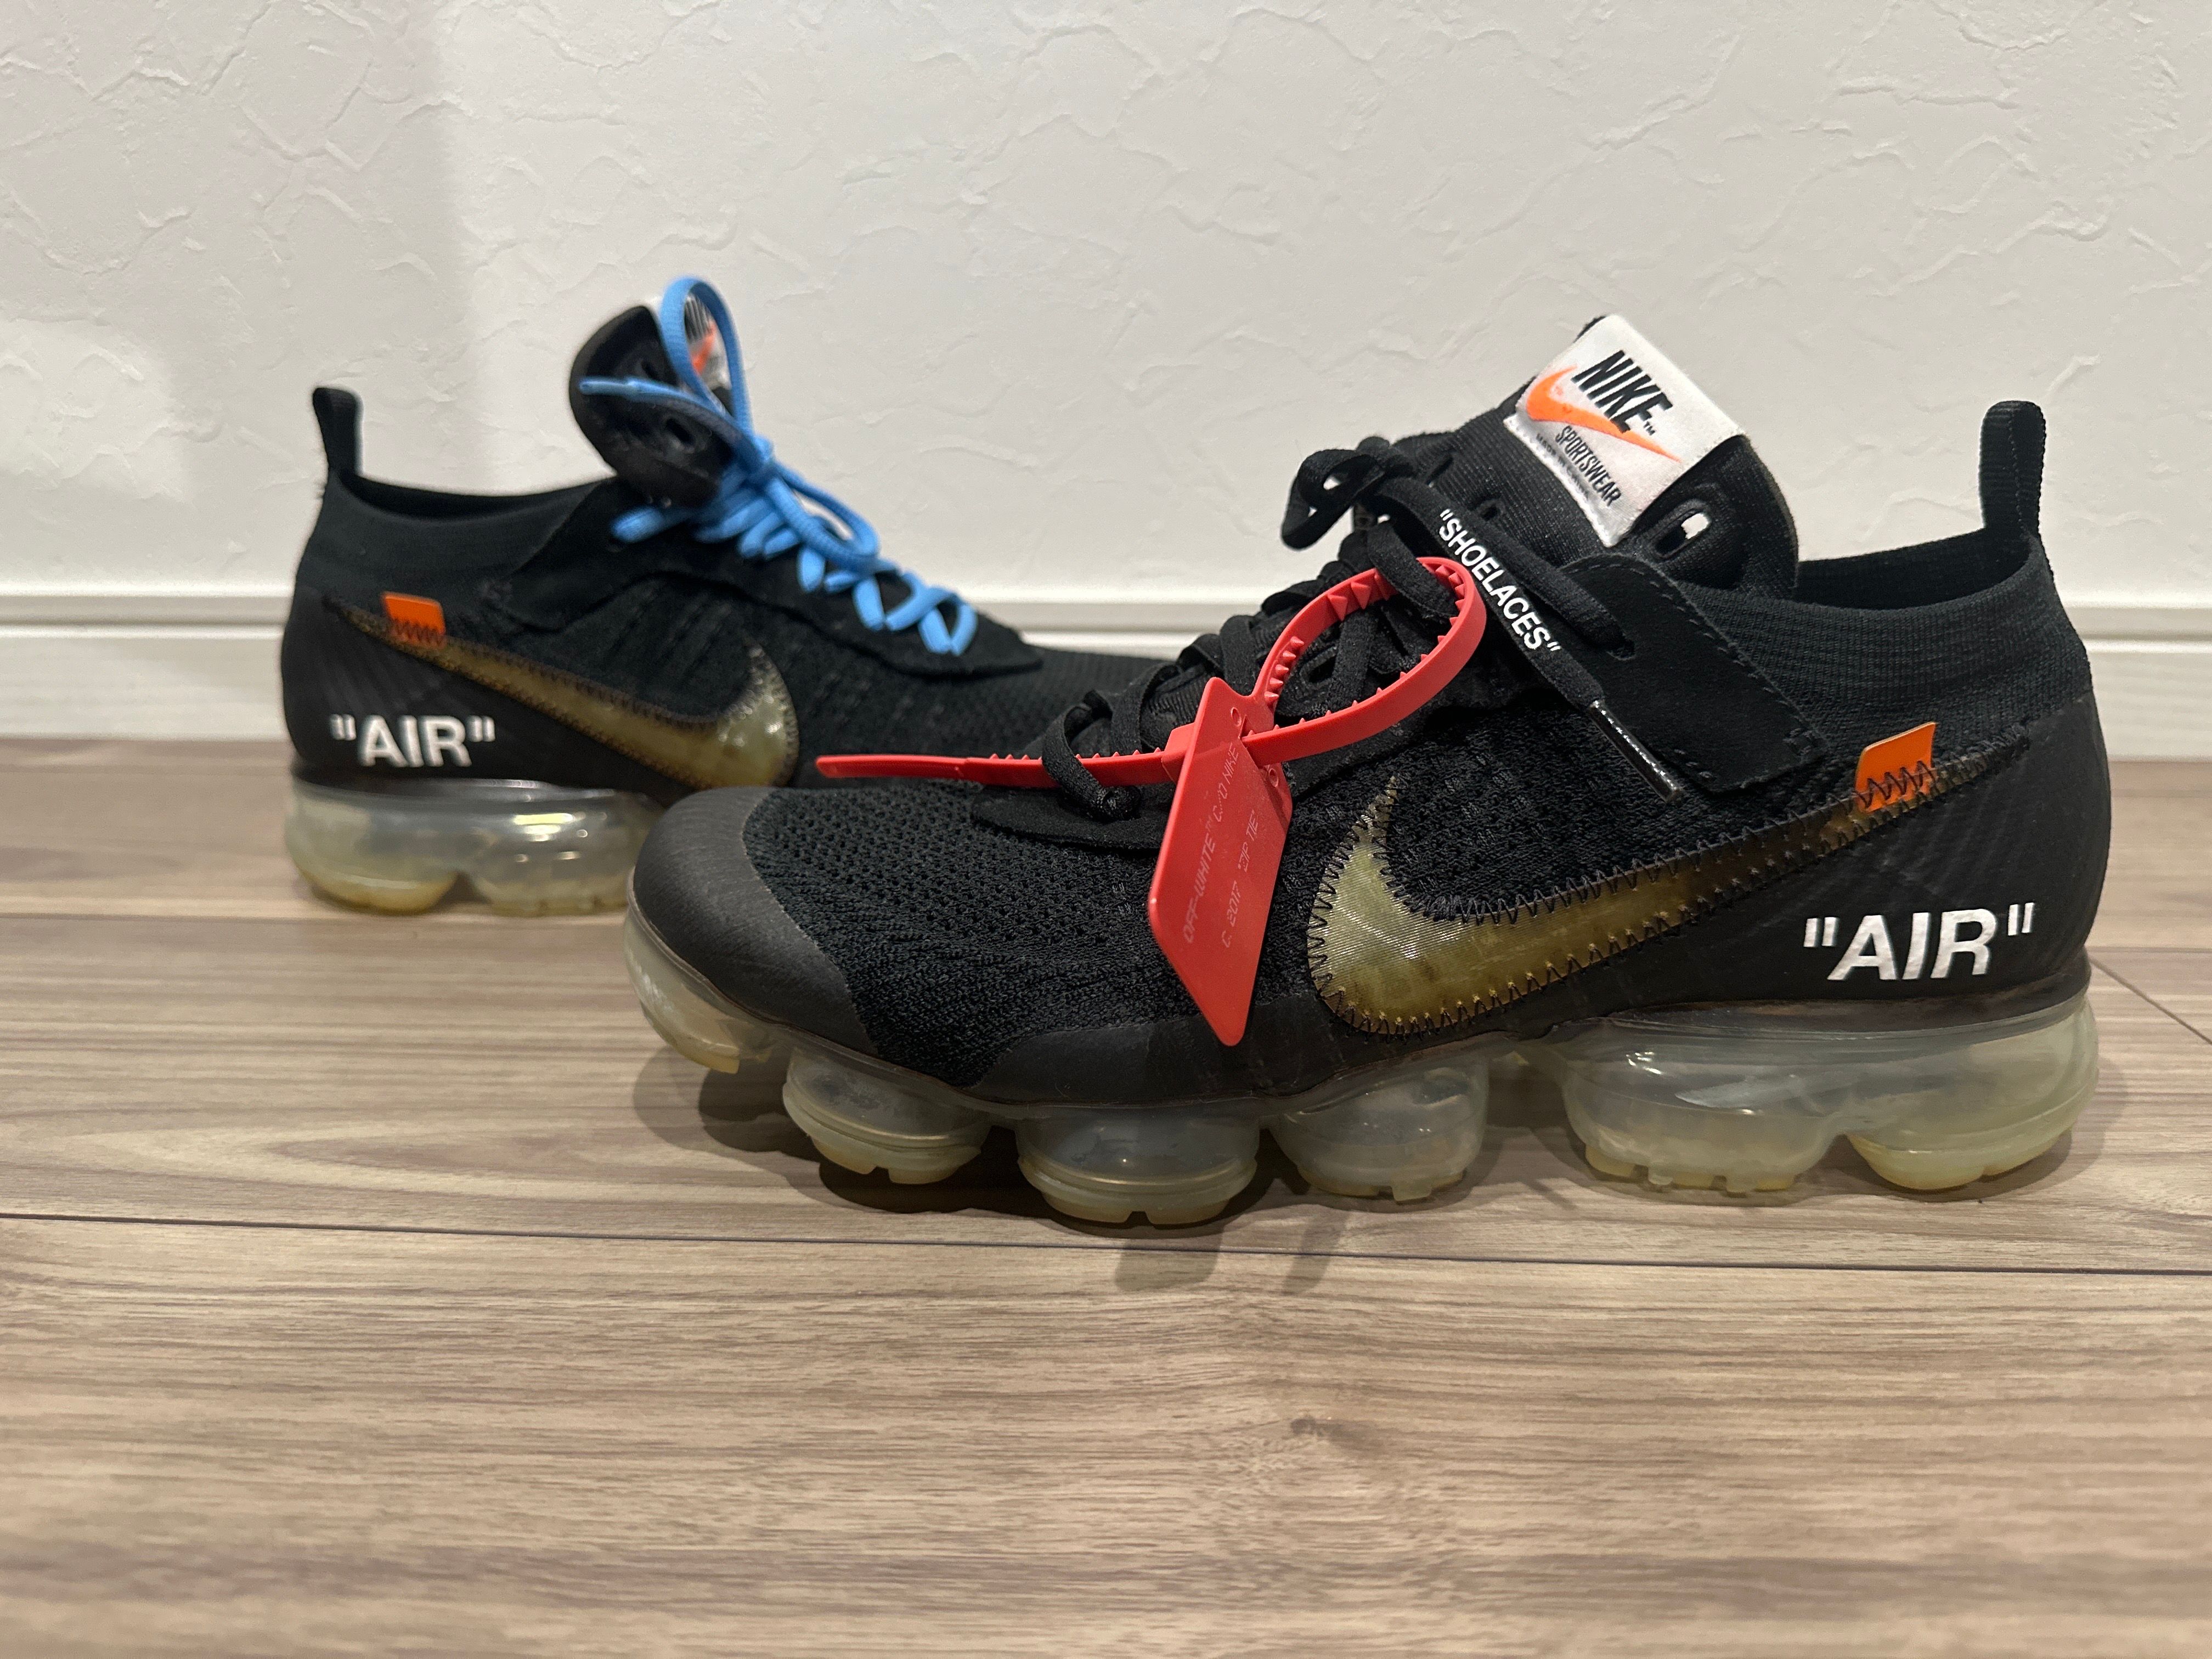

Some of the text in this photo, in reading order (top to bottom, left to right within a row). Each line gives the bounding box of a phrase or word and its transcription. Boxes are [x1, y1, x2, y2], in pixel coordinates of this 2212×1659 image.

[1555, 425, 1622, 506] SPORTSWEAR
[1439, 509, 1561, 652] "SHOELACES"
[329, 713, 495, 768] "AIR"
[1222, 742, 1239, 785] NIKE
[1227, 880, 1241, 927] 2017
[1803, 902, 2035, 981] "AIR"
